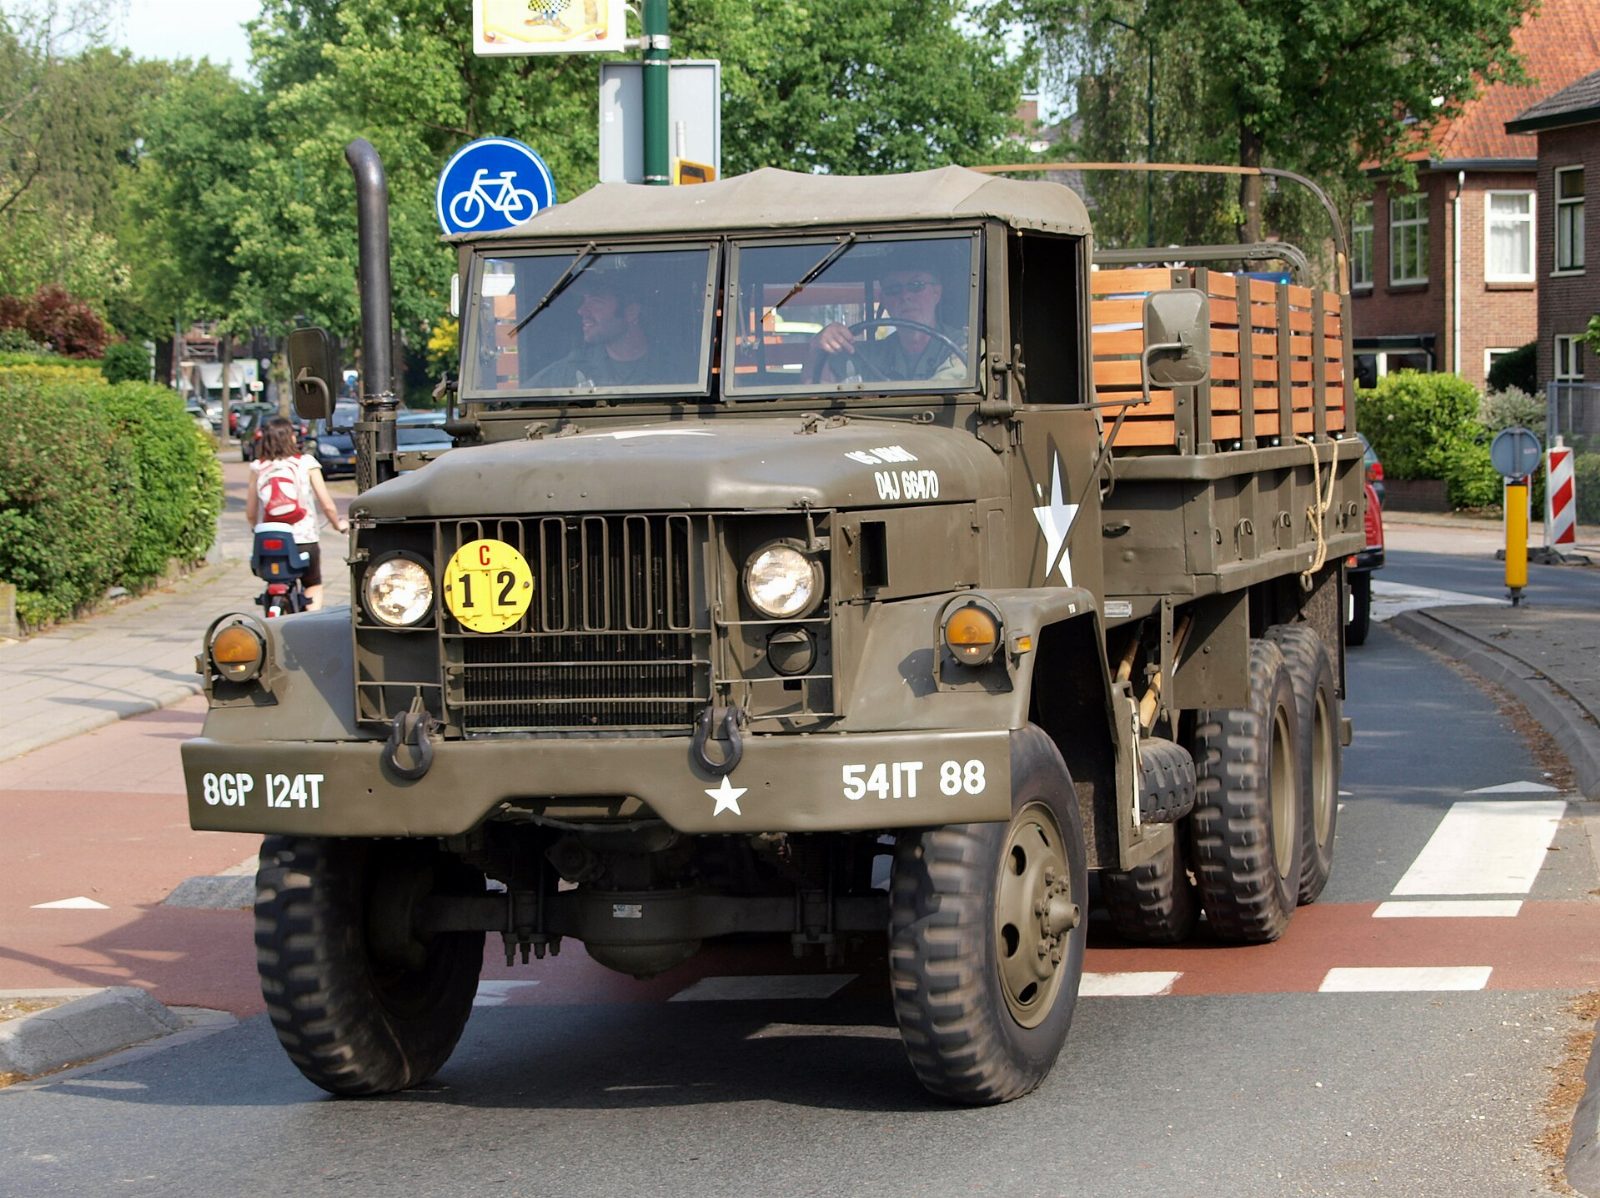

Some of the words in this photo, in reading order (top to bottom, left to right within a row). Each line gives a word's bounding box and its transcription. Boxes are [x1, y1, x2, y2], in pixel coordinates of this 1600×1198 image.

[479, 545, 490, 566] C
[202, 772, 254, 807] 8GP
[939, 759, 986, 796] 88
